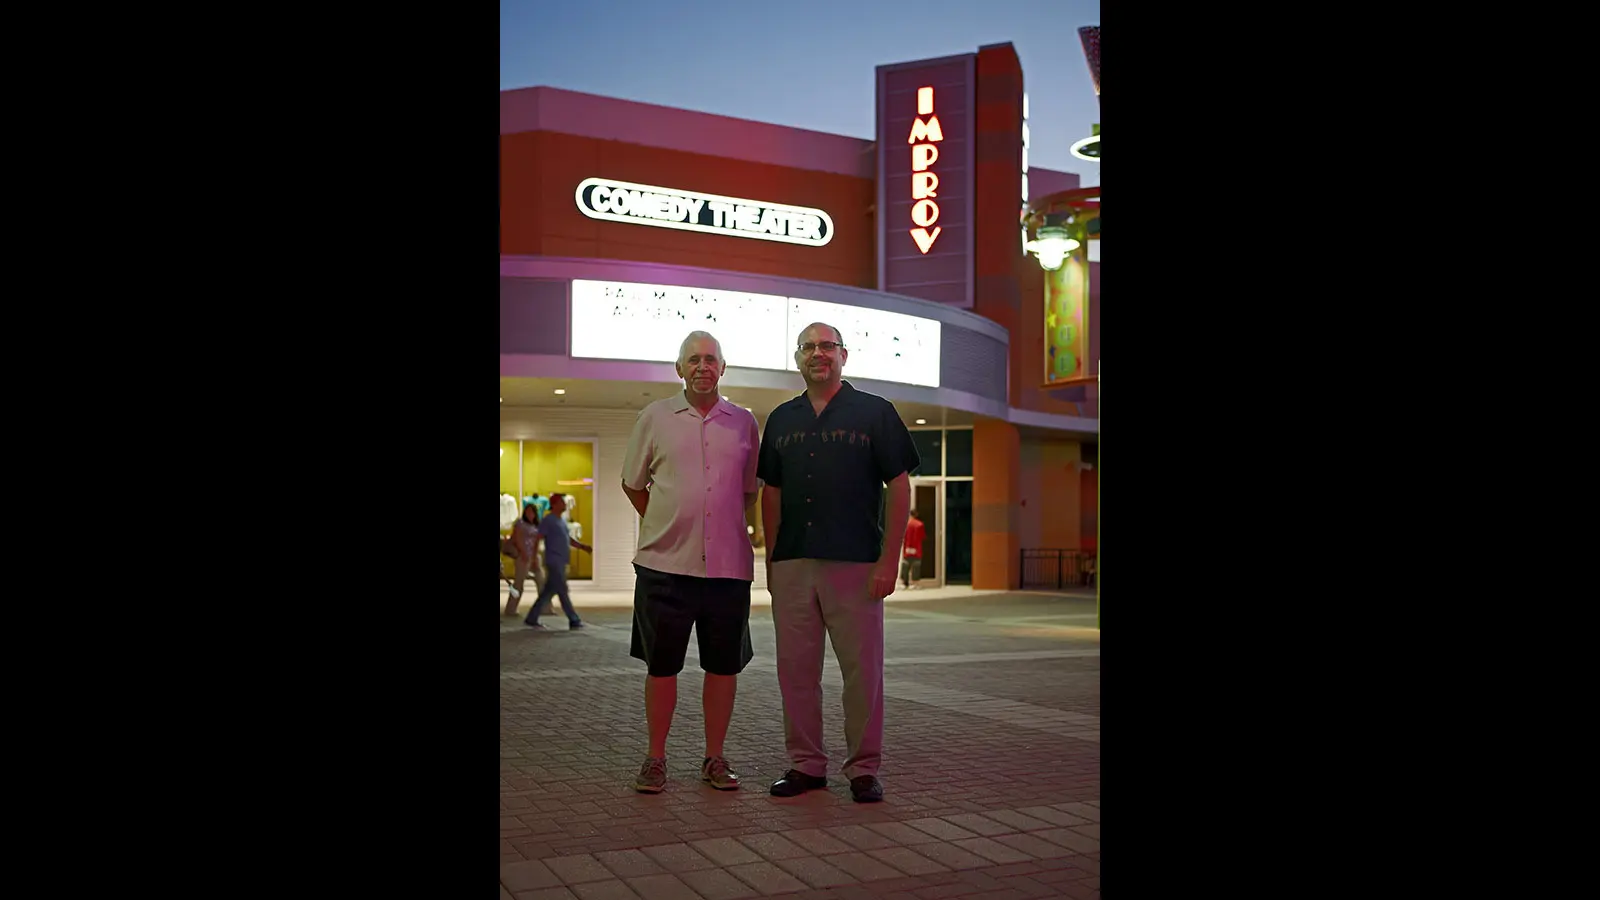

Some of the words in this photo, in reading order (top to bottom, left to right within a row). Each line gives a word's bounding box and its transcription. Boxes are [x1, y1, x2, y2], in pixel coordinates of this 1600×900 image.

[590, 184, 704, 224] COMEDY
[708, 200, 822, 240] THEATER
[908, 86, 943, 255] IMPROV
